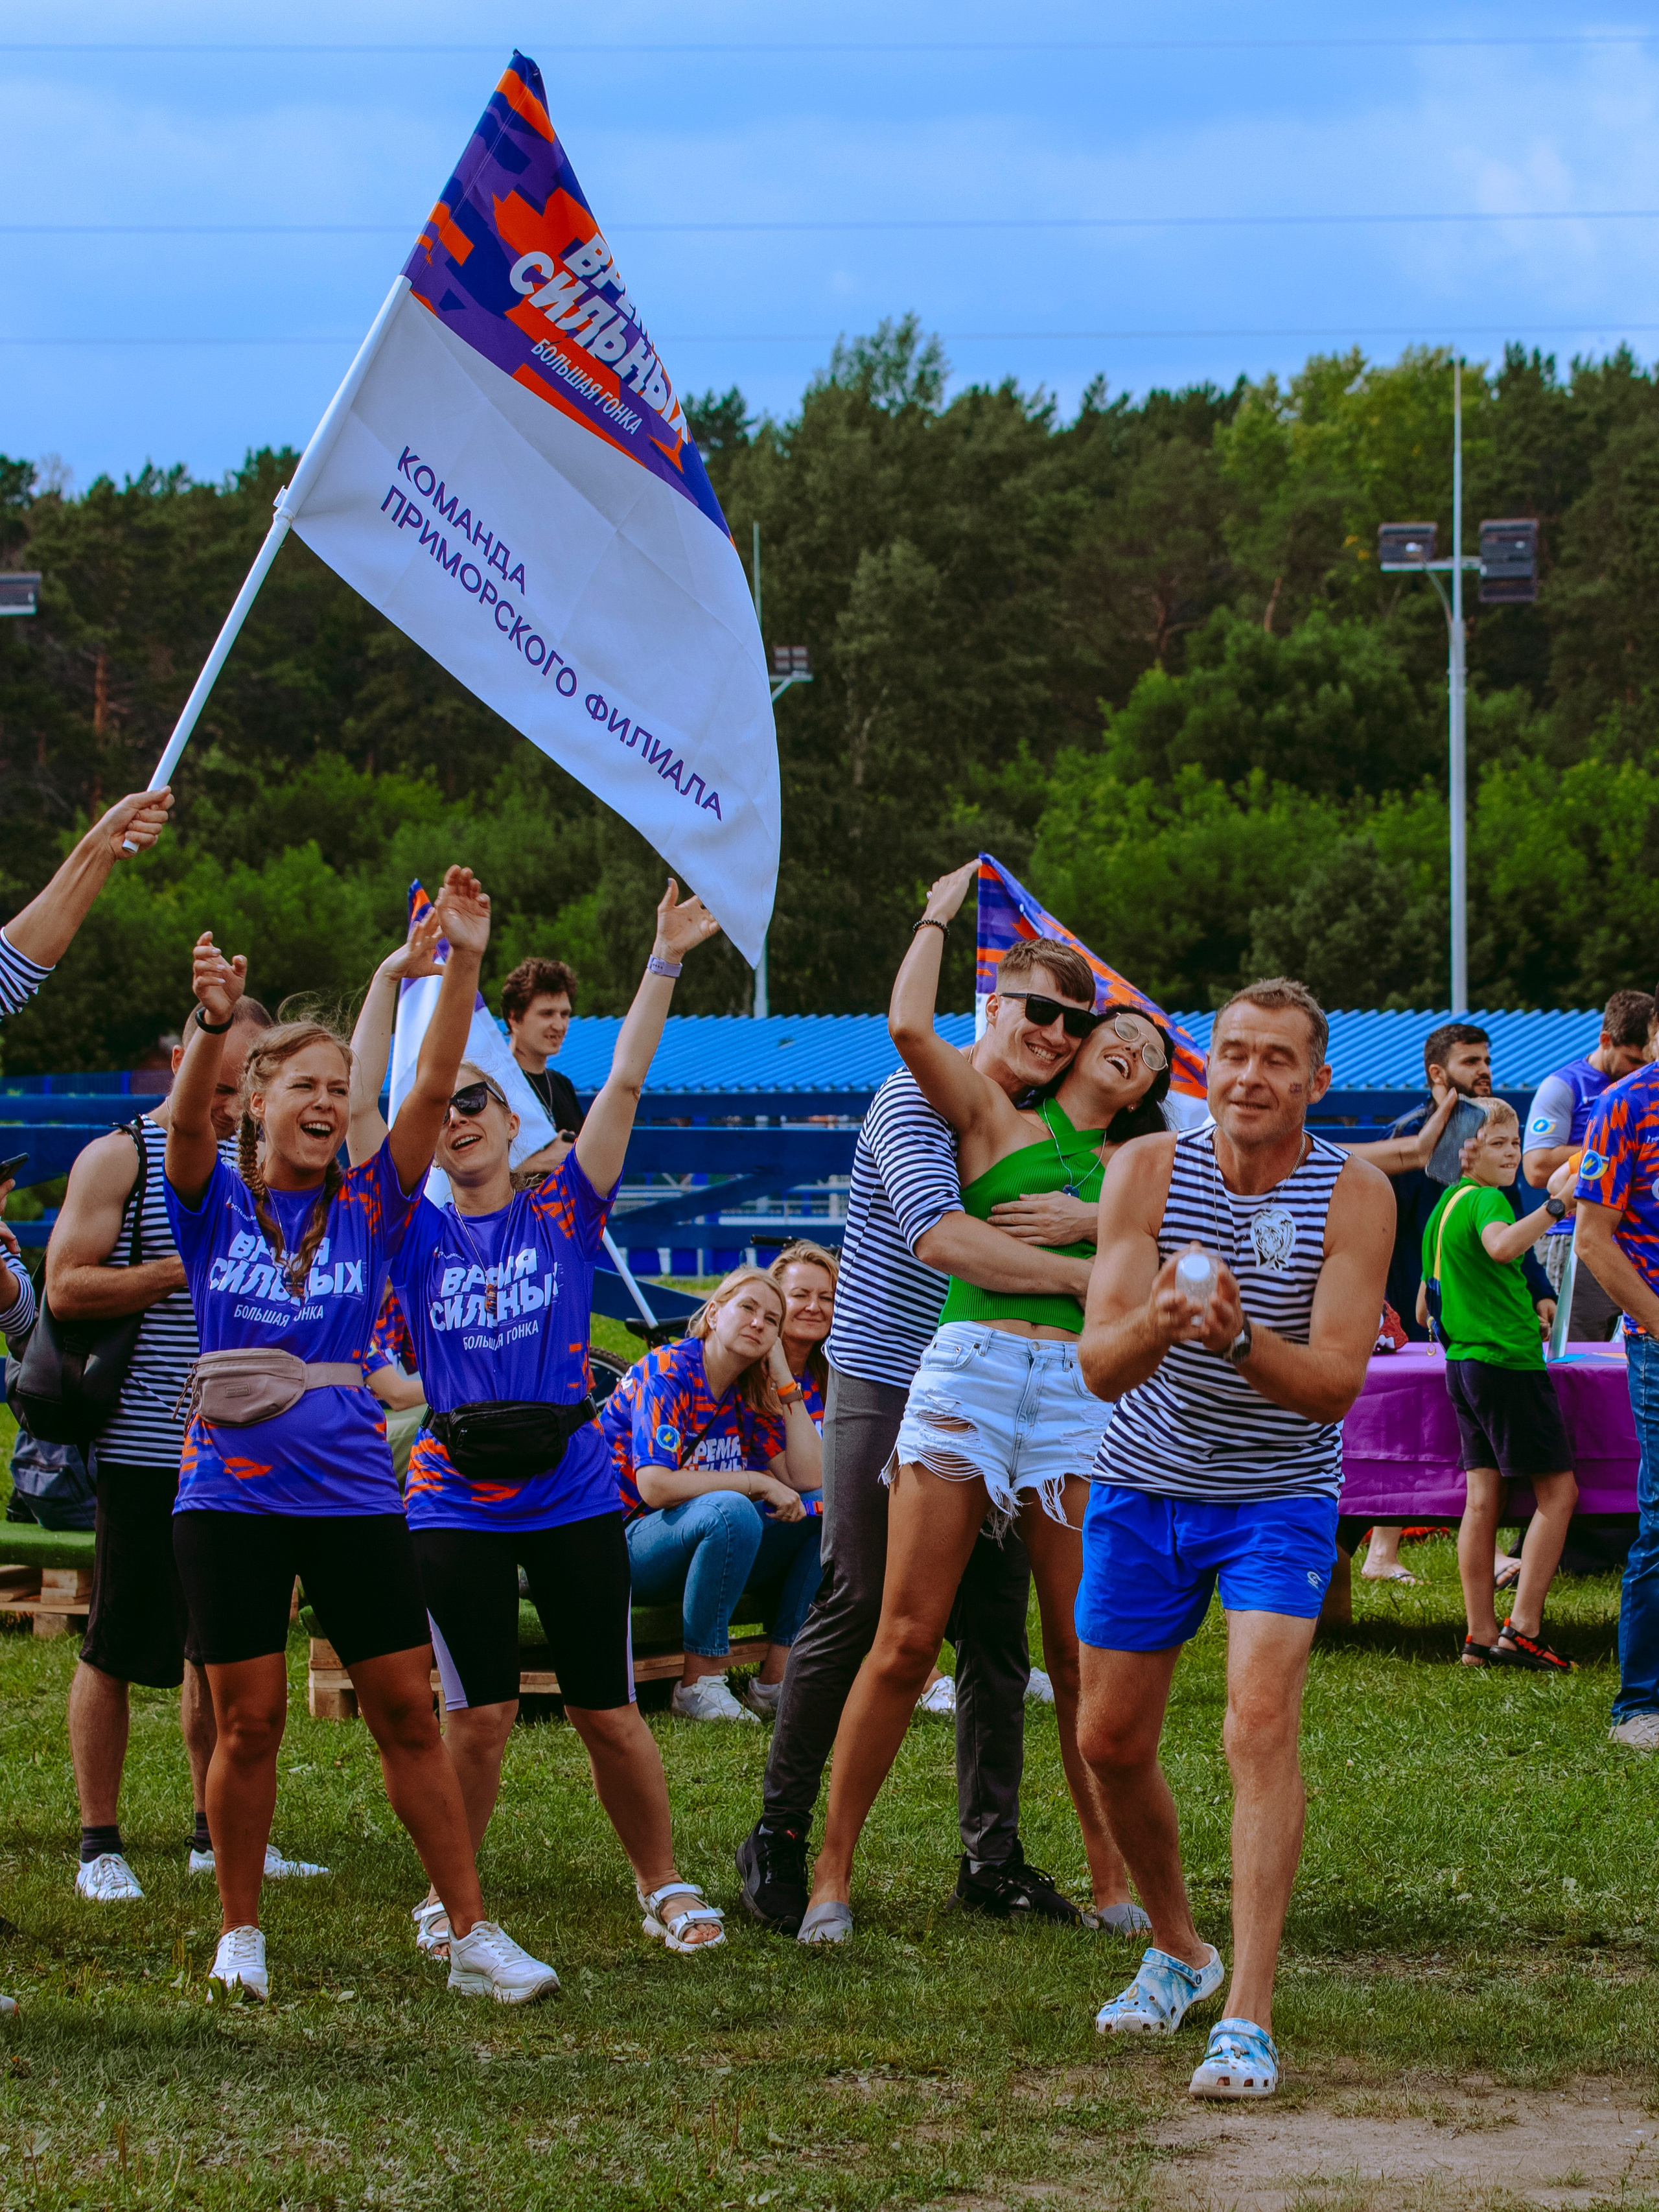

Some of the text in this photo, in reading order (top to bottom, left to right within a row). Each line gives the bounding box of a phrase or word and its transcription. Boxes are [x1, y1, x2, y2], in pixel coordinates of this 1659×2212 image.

[531, 338, 643, 435] БОЛЬШАЯ ГОНКА
[397, 445, 526, 596] КОМАНДА
[380, 485, 722, 822] ПРИМОРСКОГО ФИЛИАЛА
[209, 1257, 364, 1307] СИЛЬЫХ
[234, 1304, 290, 1327] БОЛЬШАЯ
[507, 1320, 539, 1344] ГОНКА
